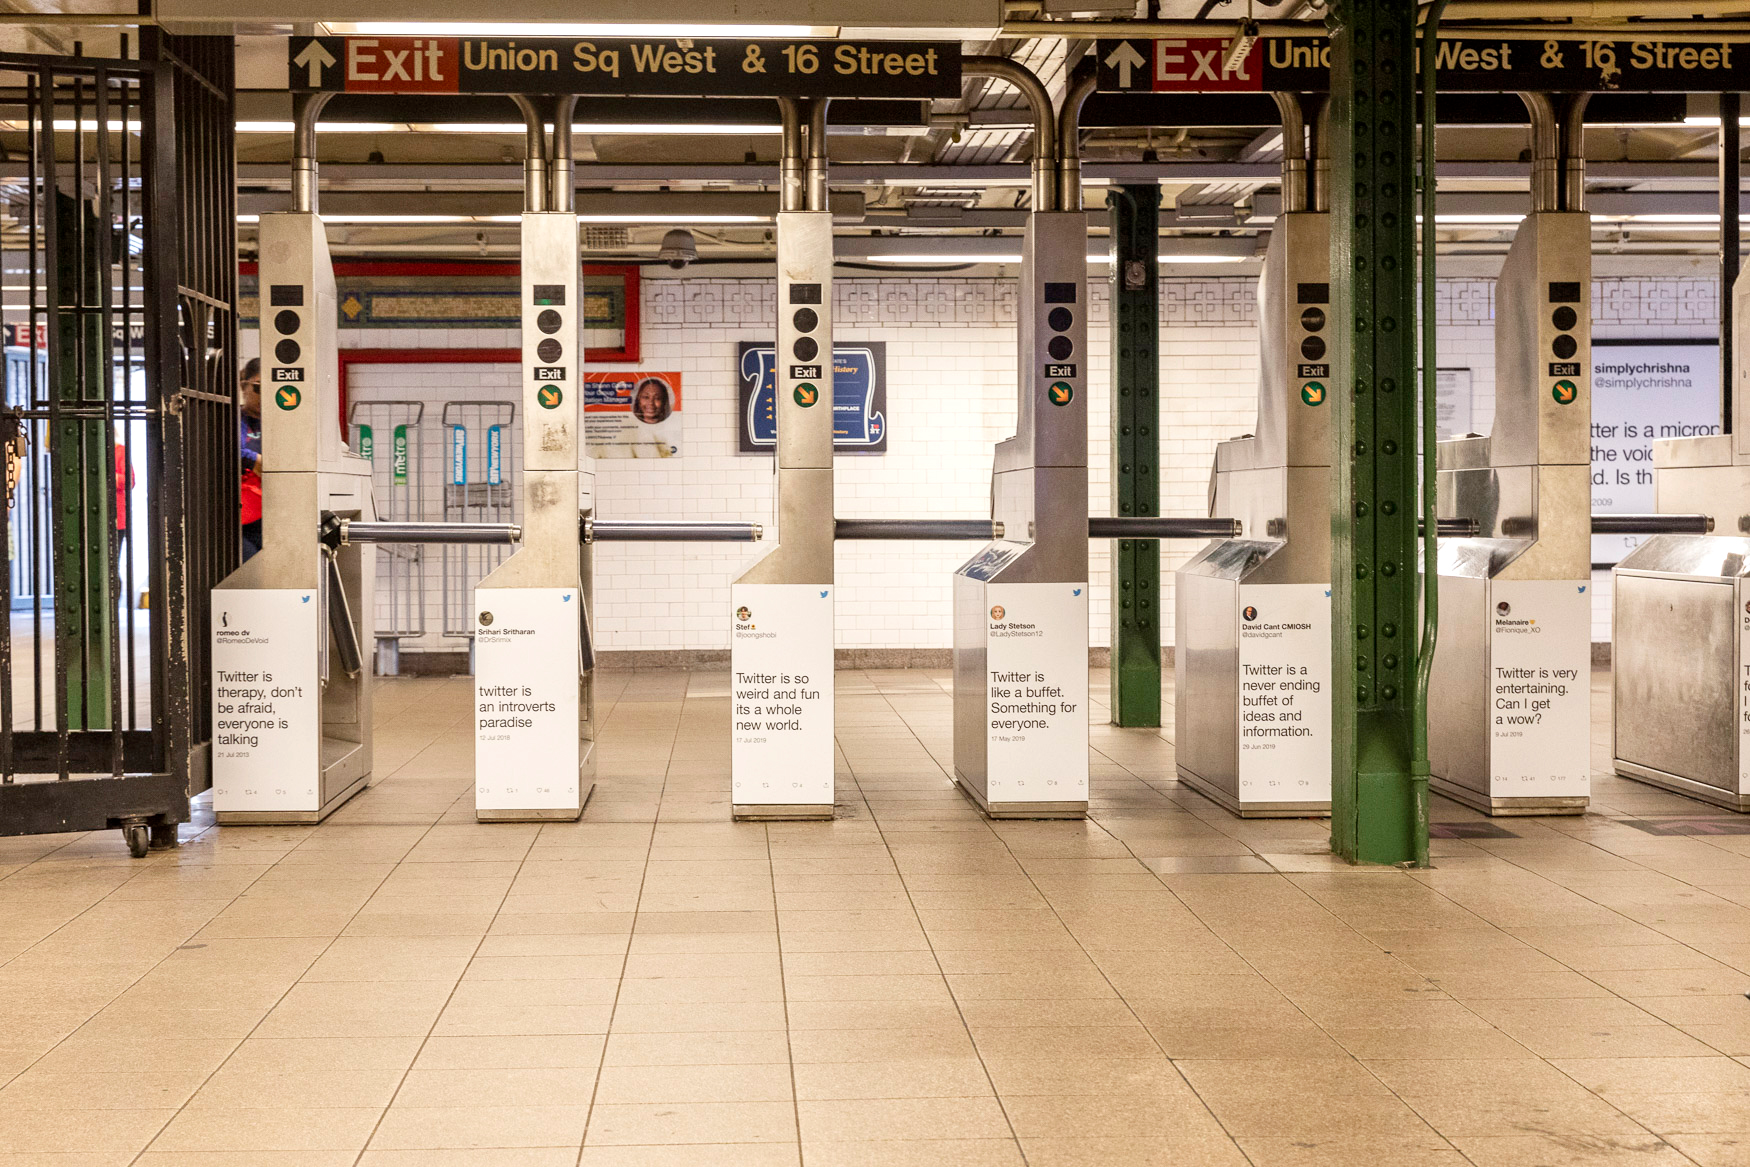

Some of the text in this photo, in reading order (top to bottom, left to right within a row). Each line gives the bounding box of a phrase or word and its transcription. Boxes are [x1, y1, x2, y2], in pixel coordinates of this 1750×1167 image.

[348, 40, 938, 81] Exit Union Sq West & 16 Street
[1436, 41, 1512, 71] West
[1540, 40, 1564, 69] &
[1579, 41, 1616, 69] 16
[1630, 41, 1733, 70] Street
[277, 370, 299, 380] Exit
[538, 369, 562, 380] Exit
[794, 367, 817, 378] Exit
[1049, 366, 1071, 377] Exit
[1302, 366, 1324, 377] Exit
[1553, 365, 1575, 375] Exit
[1595, 363, 1690, 376] simplychrishna
[1596, 377, 1692, 390] @simplychrishna
[1624, 422, 1637, 438] is
[1643, 425, 1654, 438] a
[395, 437, 407, 474] metro
[1616, 470, 1629, 485] Is
[736, 631, 776, 639] @joongshobi
[990, 630, 1043, 638] @LadyStetson12
[1242, 631, 1282, 639] @davidgcant
[1243, 663, 1307, 675] Twitter is a
[1496, 666, 1577, 680] Twitter is very
[217, 670, 272, 682] Twitter is
[736, 672, 809, 684] Twitter is so
[991, 671, 1044, 682] Twitter is
[479, 685, 531, 696] twitter is
[992, 686, 1064, 698] like a buffet.
[1243, 679, 1320, 693] never ending
[1496, 682, 1568, 696] entertaining.
[217, 686, 266, 700] therapy,
[736, 688, 819, 699] weird and fun
[480, 700, 555, 712] an introverts
[1243, 694, 1293, 706] buffet of
[1496, 697, 1550, 711] Can I get
[218, 701, 275, 714] be afraid,
[737, 703, 802, 715] its a whole
[992, 701, 1077, 715] Something for
[1244, 709, 1301, 721] ideas and
[1496, 712, 1541, 724] a wow?
[218, 717, 288, 732] everyone is
[480, 716, 532, 730] paradise
[737, 719, 802, 730] new world.
[991, 719, 1048, 731] everyone.
[1244, 725, 1312, 736] information.
[218, 733, 258, 747] talking
